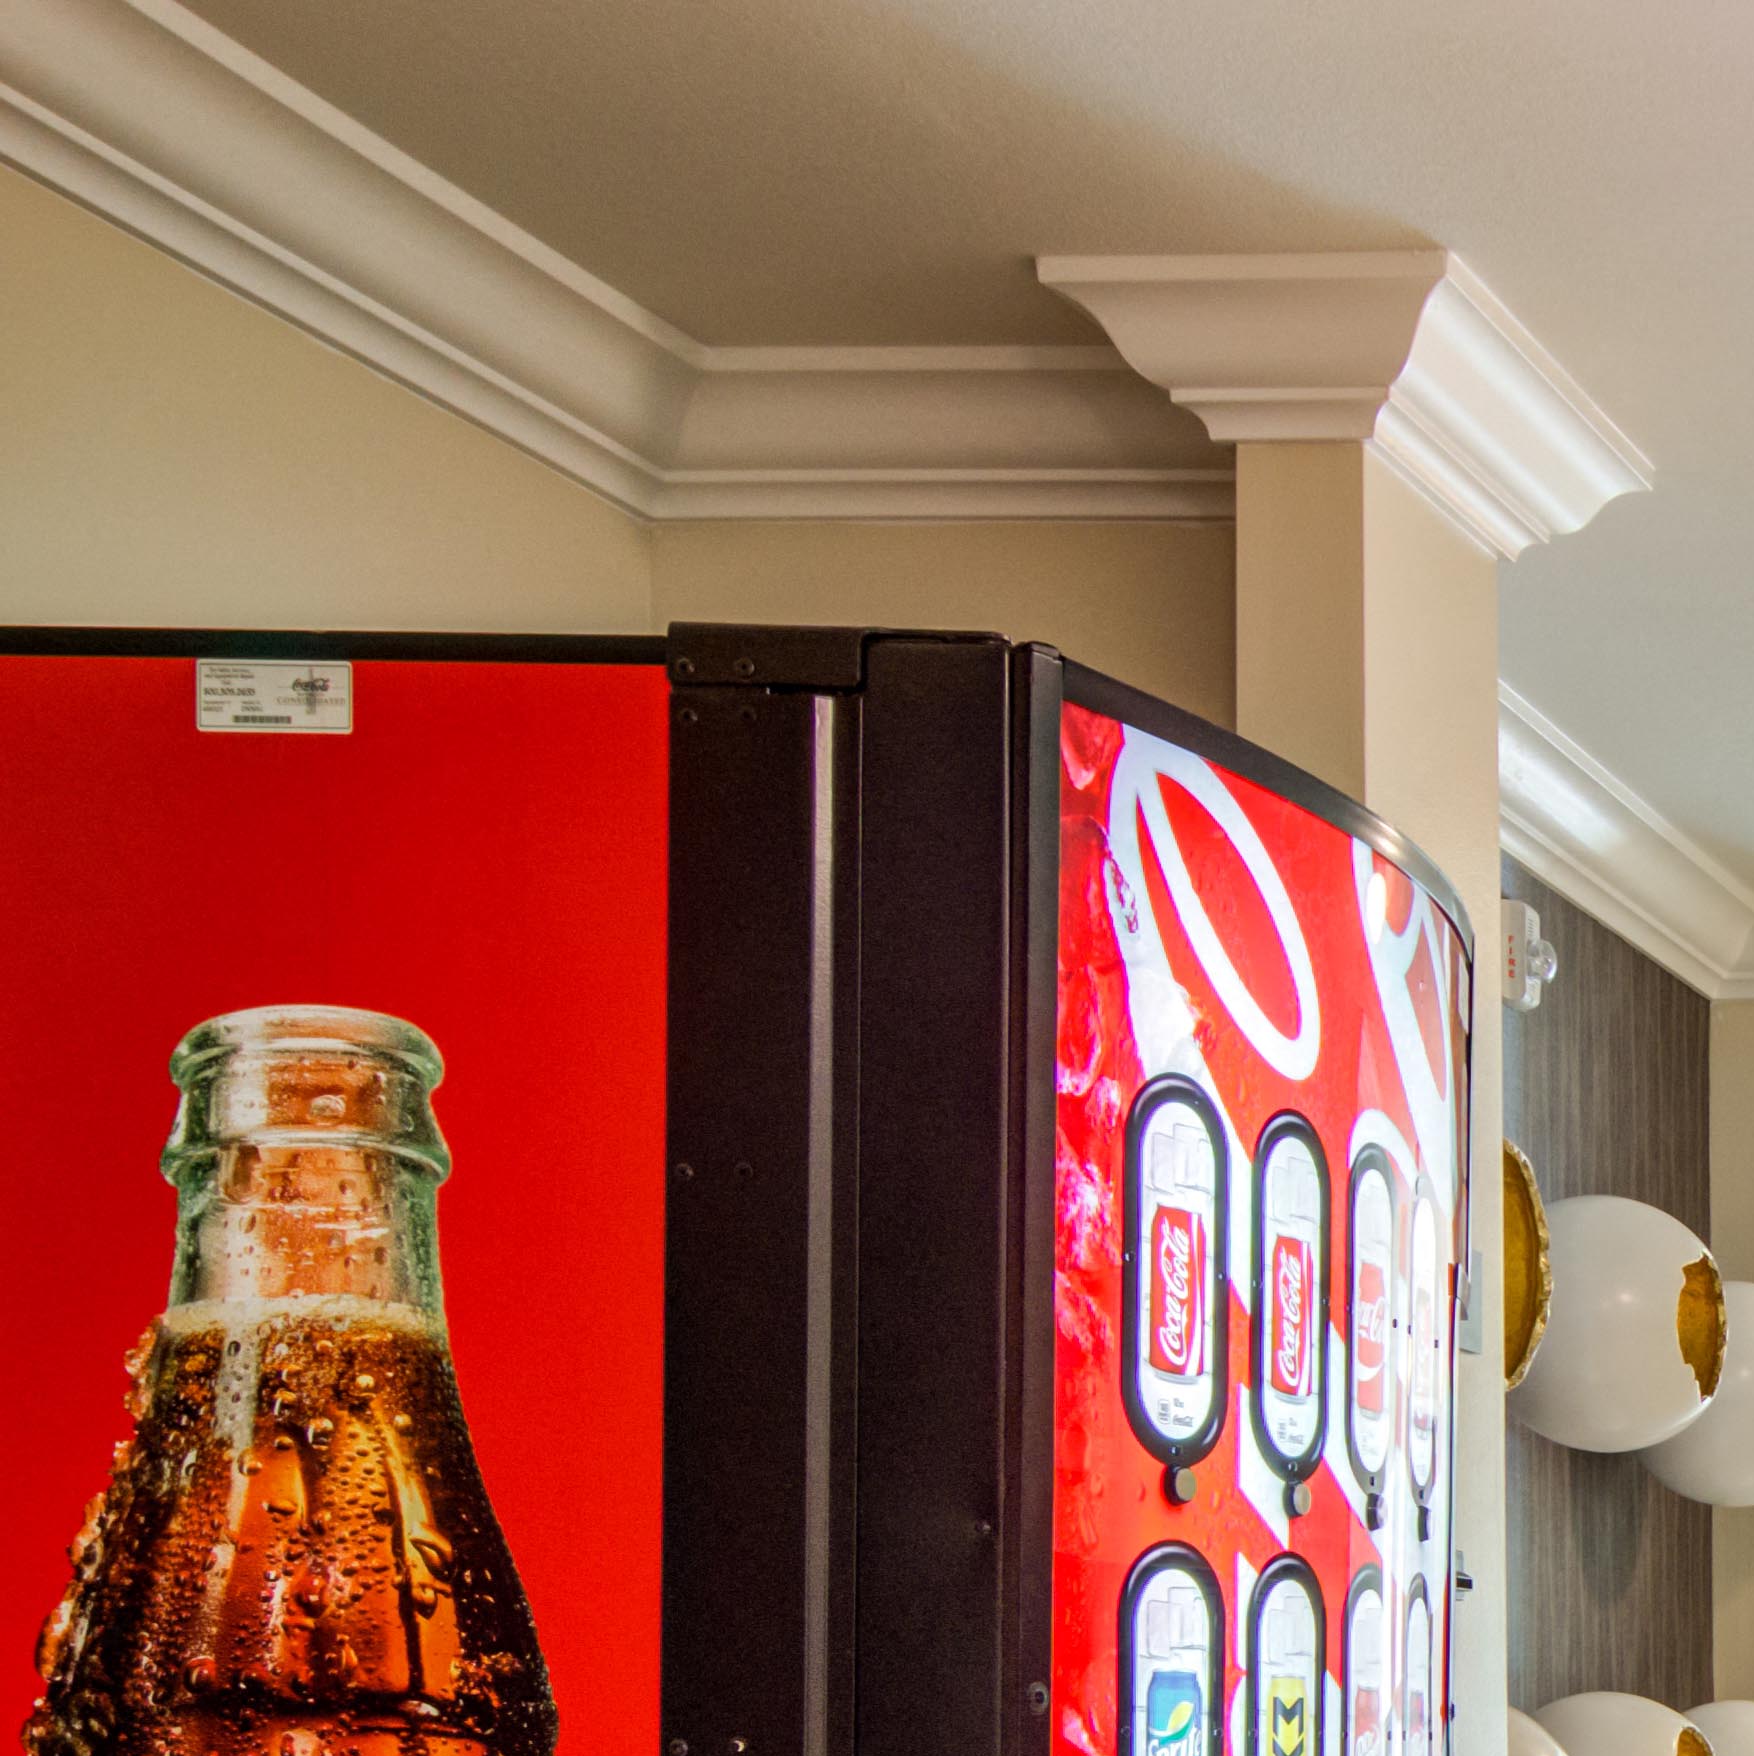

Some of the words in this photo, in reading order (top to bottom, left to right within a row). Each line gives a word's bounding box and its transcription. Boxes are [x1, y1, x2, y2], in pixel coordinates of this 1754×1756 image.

[1507, 935, 1517, 979] FIRE
[1158, 1215, 1190, 1366] Coca-Cola
[1277, 1246, 1301, 1387] Coca-Cola
